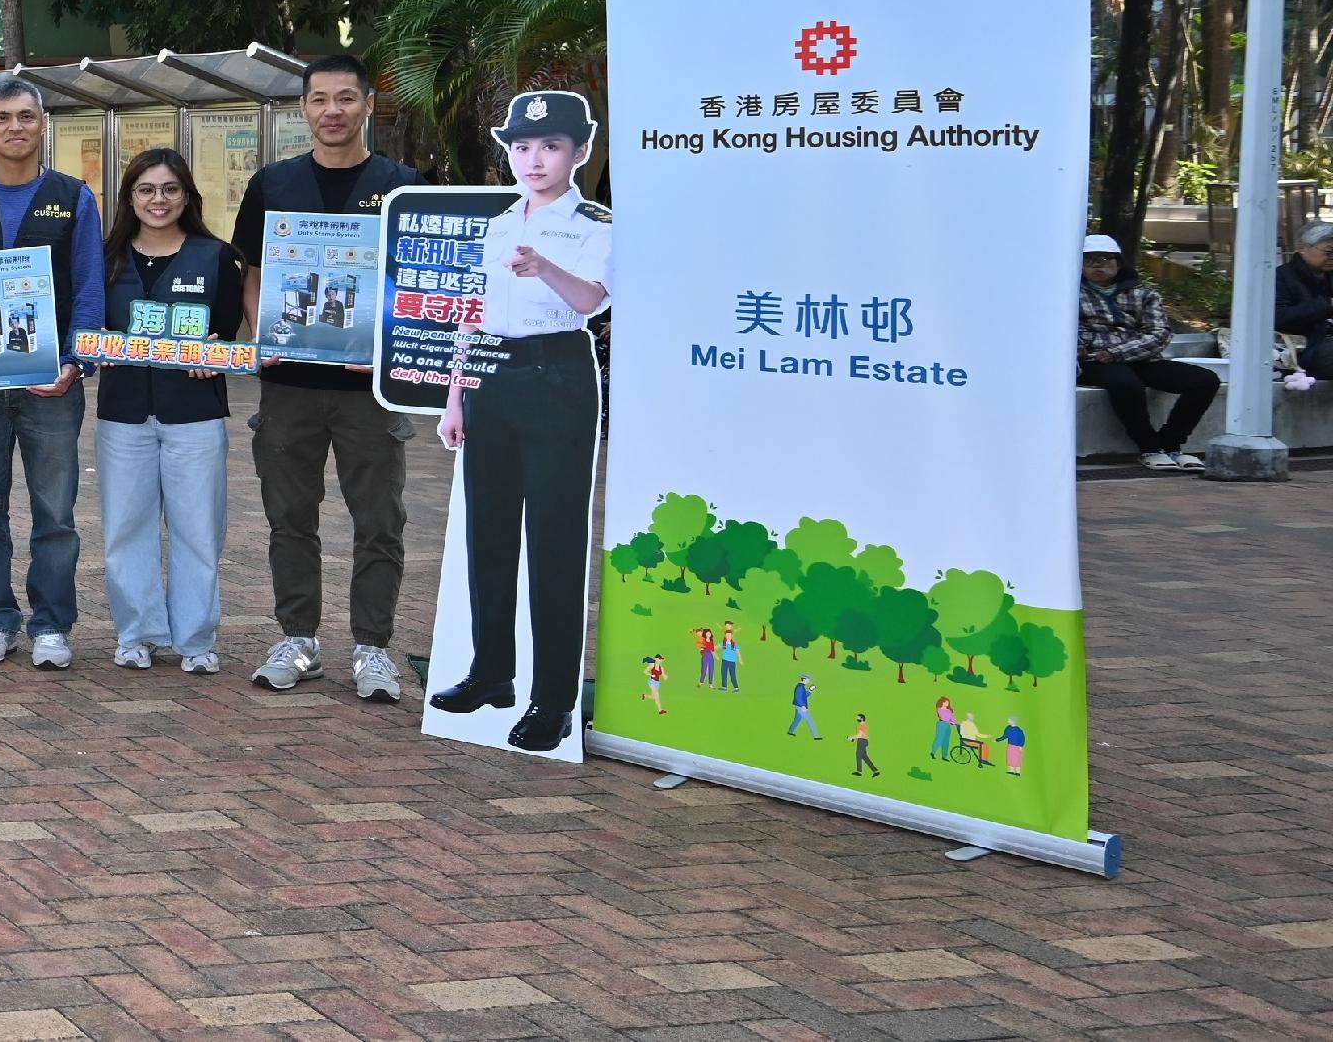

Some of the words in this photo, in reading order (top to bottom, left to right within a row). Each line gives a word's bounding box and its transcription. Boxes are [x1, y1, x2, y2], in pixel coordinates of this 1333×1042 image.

[699, 86, 966, 119] 香港房屋委員會
[640, 127, 704, 155] Hong
[713, 127, 778, 154] Kong
[785, 126, 898, 153] Housing
[906, 123, 1041, 152] Authority
[359, 200, 384, 208] CUST
[397, 213, 488, 237] 私煙罪行
[396, 237, 485, 268] 新刑責
[396, 268, 487, 294] 違者必究
[131, 302, 205, 338] 海關
[394, 292, 484, 325] 要守法
[735, 290, 914, 344] 美林邨
[392, 326, 421, 339] New
[420, 330, 481, 345] penalties
[392, 340, 419, 351] illicit
[420, 343, 464, 355] cigarette
[465, 348, 511, 360] offences
[392, 352, 413, 364] No
[416, 358, 443, 369] one
[446, 359, 498, 374] should
[390, 368, 422, 384] defy
[424, 370, 450, 386] the
[451, 374, 482, 389] law
[690, 344, 745, 370] Mei
[759, 349, 833, 376] Lam
[850, 355, 968, 387] Estate
